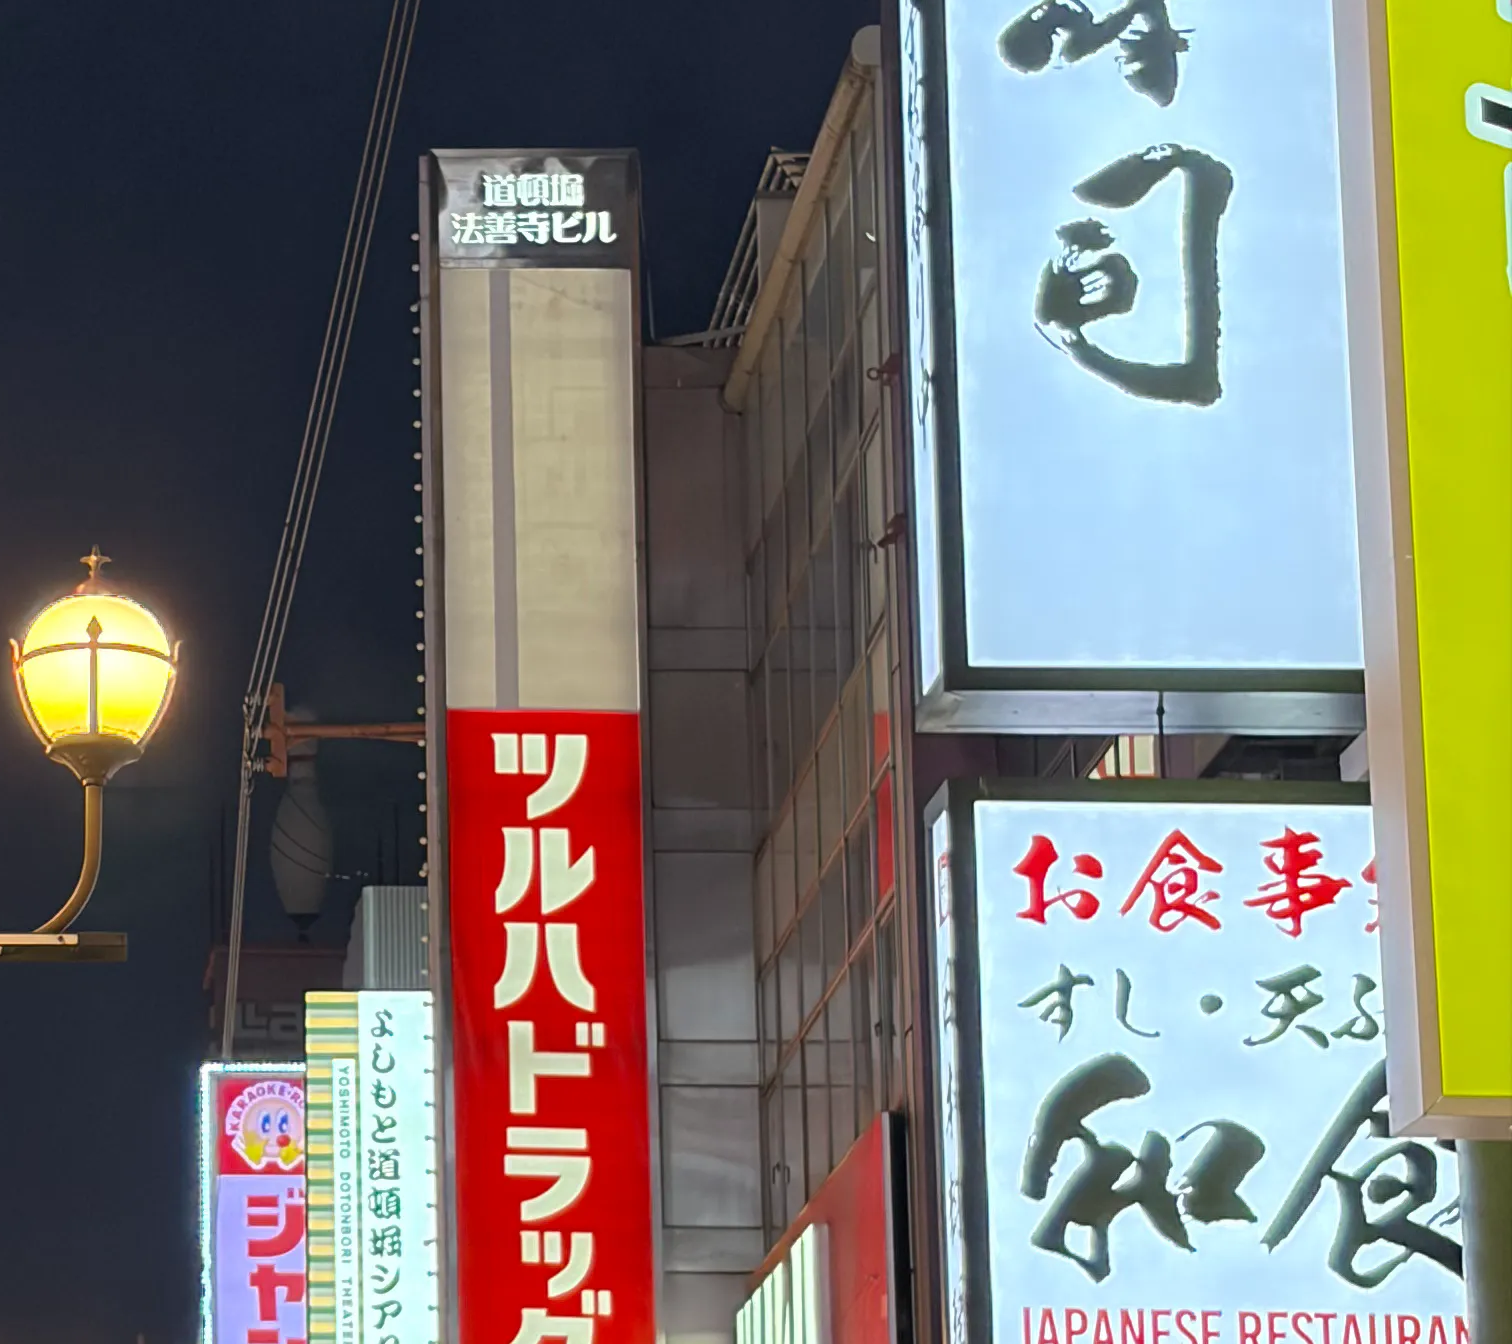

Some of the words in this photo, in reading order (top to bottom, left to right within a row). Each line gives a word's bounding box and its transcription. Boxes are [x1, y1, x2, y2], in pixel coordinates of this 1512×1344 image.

[450, 211, 617, 245] 法善寺ビル
[482, 173, 584, 207] 道頓堀
[1013, 826, 1382, 937] お食事
[337, 1066, 351, 1159] YOSHIMOTO
[1020, 1052, 1467, 1289] 和食
[339, 1171, 353, 1264] DOTONBORI
